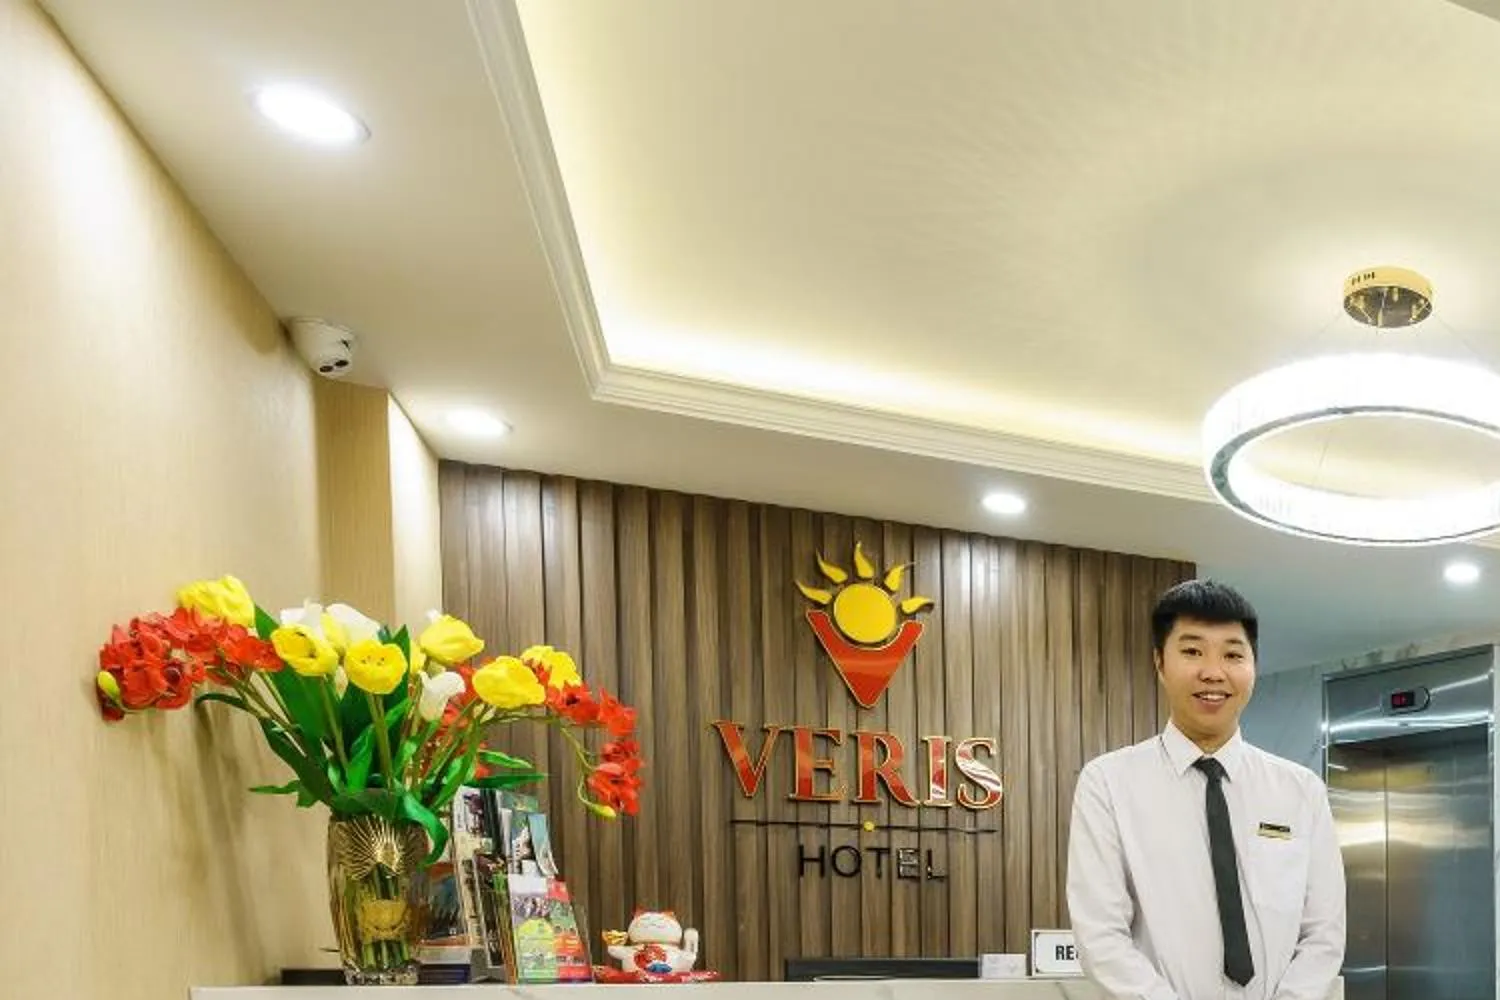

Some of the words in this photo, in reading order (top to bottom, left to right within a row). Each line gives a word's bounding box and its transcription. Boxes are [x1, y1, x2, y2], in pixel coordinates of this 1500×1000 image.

[712, 719, 1002, 809] VERIS
[799, 844, 947, 880] HOTEL
[1055, 945, 1079, 961] RE
